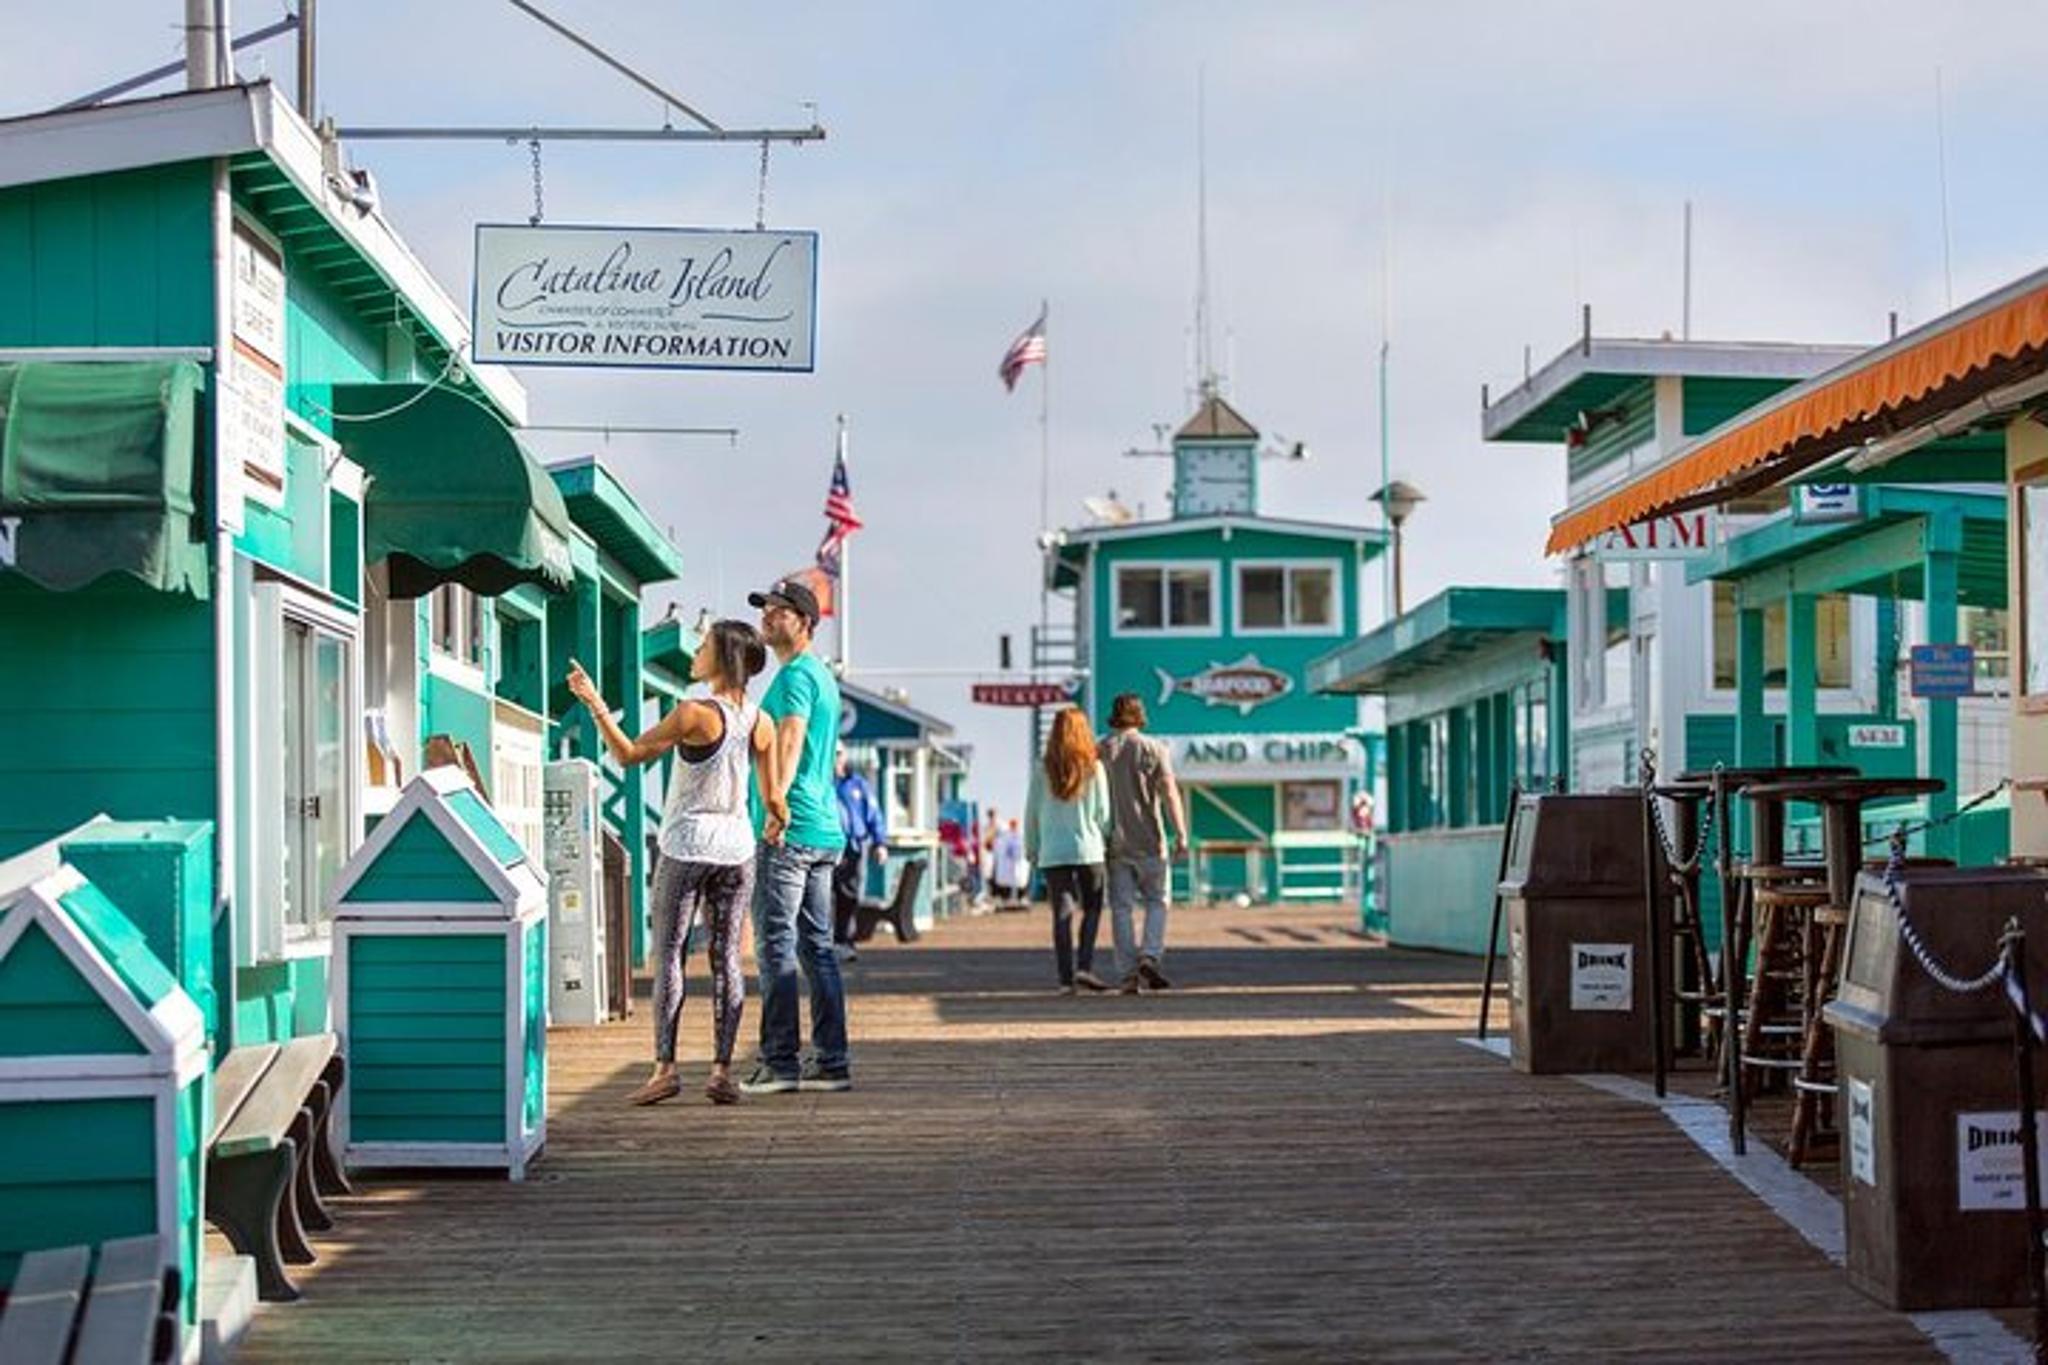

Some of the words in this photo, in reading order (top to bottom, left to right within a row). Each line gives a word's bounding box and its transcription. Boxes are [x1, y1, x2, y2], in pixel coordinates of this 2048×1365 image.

[497, 241, 662, 310] Catalina
[669, 239, 792, 308] Island
[497, 331, 596, 355] VISITOR
[602, 334, 791, 359] INFORMATION
[1606, 513, 1707, 549] ATM
[1184, 741, 1248, 764] AND
[1262, 740, 1347, 764] CHIPS
[1578, 951, 1627, 970] DRINK
[1967, 1125, 2024, 1152] DRIN
